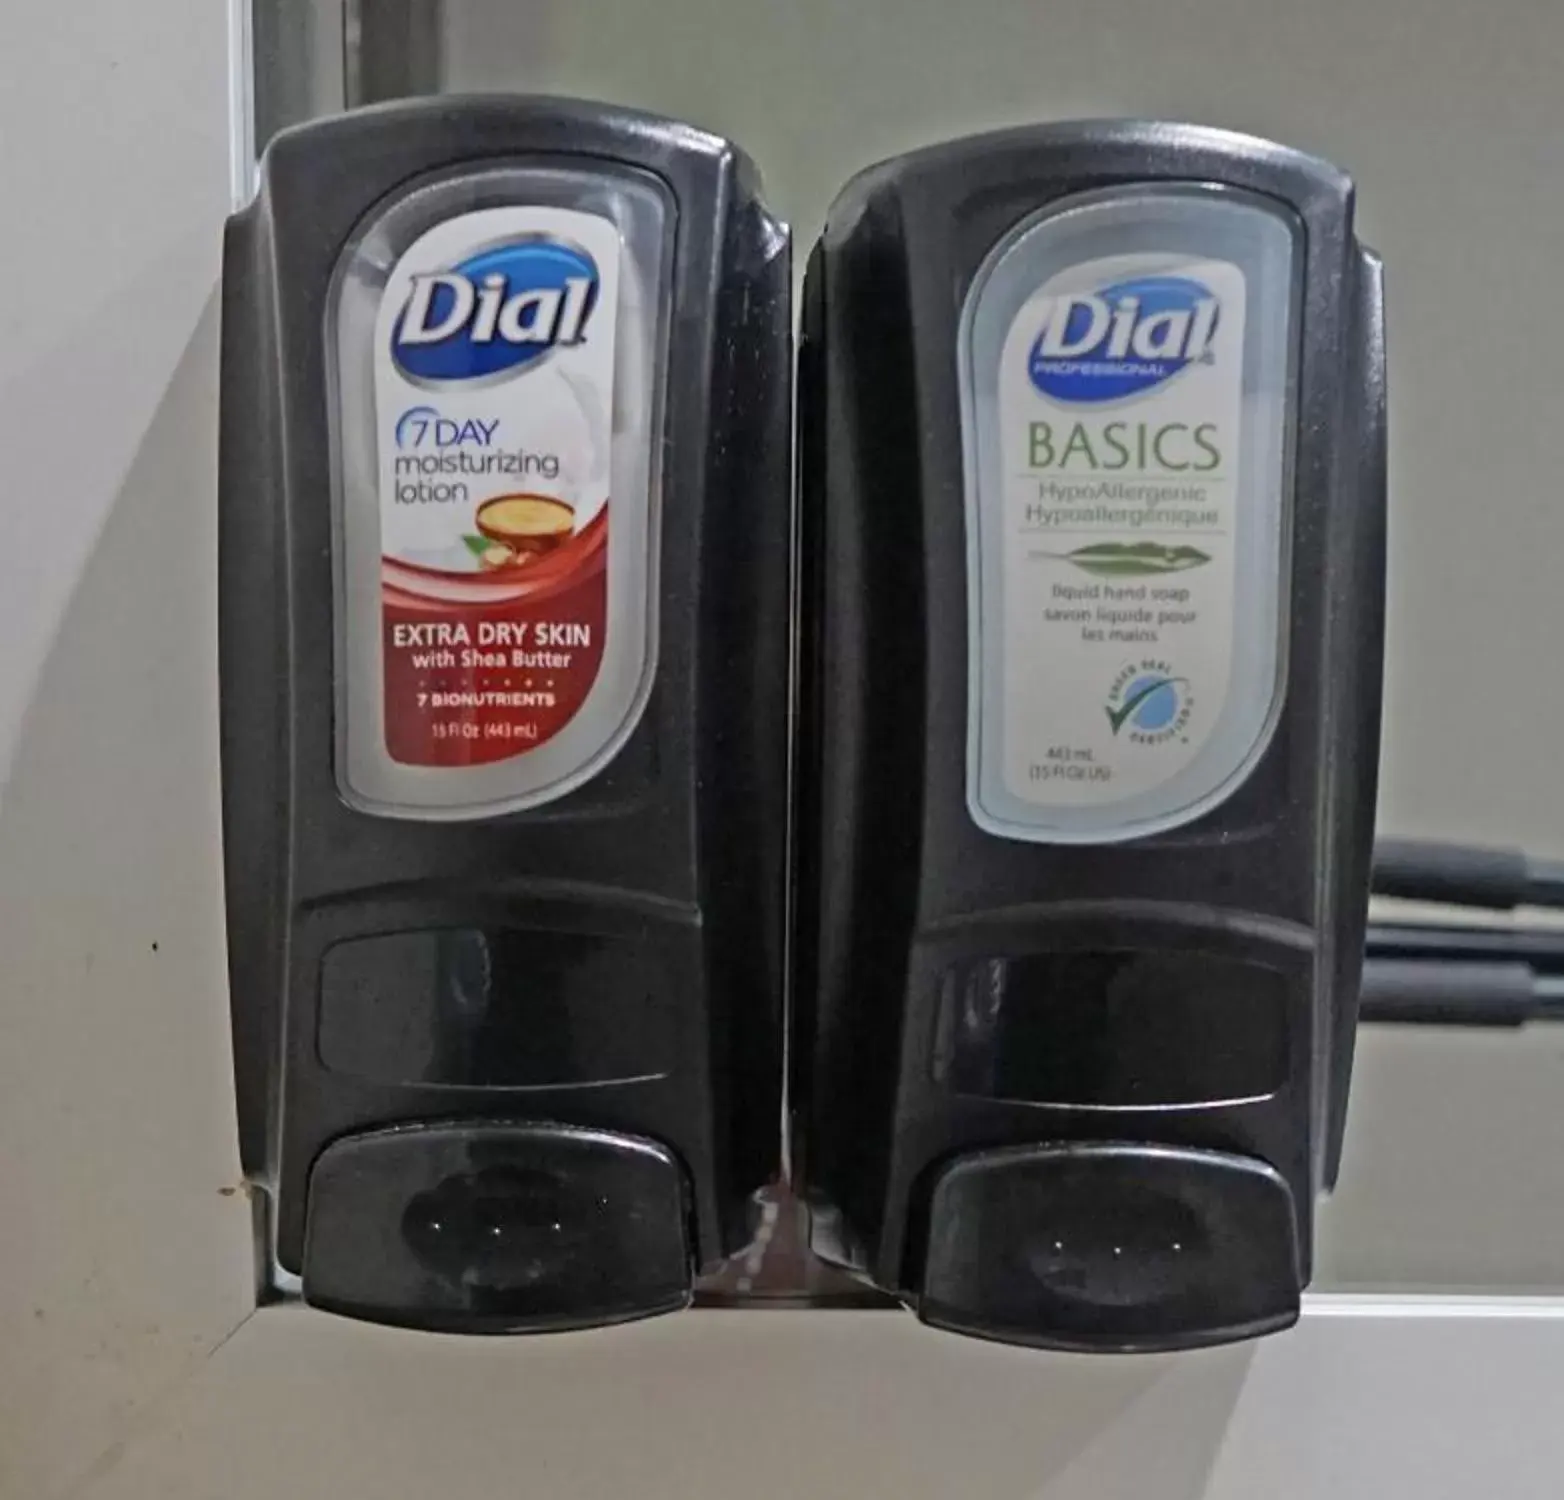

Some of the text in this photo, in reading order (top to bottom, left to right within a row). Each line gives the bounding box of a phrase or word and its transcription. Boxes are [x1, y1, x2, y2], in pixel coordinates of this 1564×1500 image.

[399, 272, 591, 346] Dial
[1039, 294, 1219, 360] Dial
[1033, 361, 1166, 376] PROFESSIONAL
[411, 419, 499, 448] 7 DAY
[1028, 420, 1221, 471] BASICS
[395, 449, 560, 480] moisturizing
[395, 482, 468, 505] lotion
[1038, 482, 1207, 506] HypoAllergenic
[1052, 583, 1190, 603] liquid hand soap
[1043, 607, 1197, 626] savon liquide pour
[393, 622, 591, 647] EXTRA DRY SKIN
[412, 650, 571, 669] with Shea Butter
[416, 692, 556, 708] 7 BIONUTRIENTS
[431, 723, 447, 739] 15
[484, 722, 511, 740] (443
